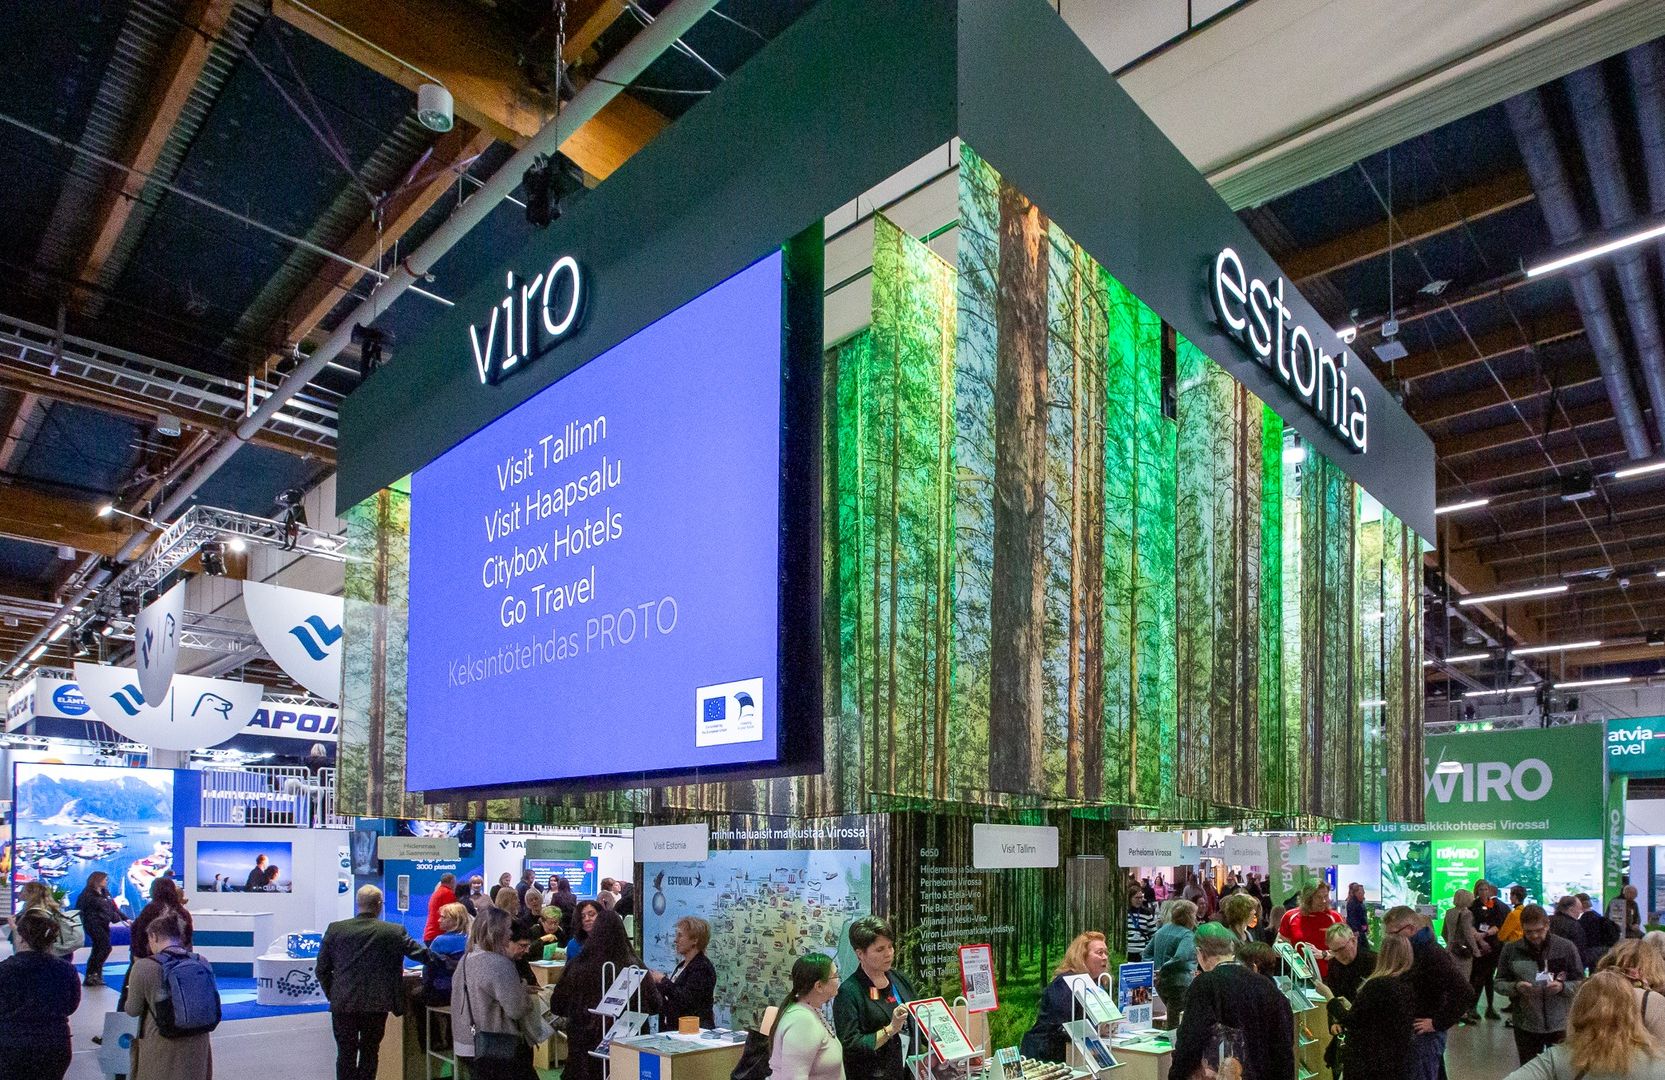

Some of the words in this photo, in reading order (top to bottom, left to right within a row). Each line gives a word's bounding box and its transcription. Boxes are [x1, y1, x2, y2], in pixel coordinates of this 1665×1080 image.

[470, 256, 580, 384] viro
[1216, 247, 1367, 454] estonia
[497, 448, 534, 491] Visit
[539, 415, 607, 470] Tallinn
[485, 501, 521, 543] Visit
[525, 456, 622, 527] Haapsalu
[482, 543, 548, 589] Citybox
[553, 506, 623, 562] Hotels
[500, 596, 526, 628] Go
[532, 566, 595, 617] Travel
[449, 631, 579, 688] Keksintötehdas
[586, 595, 678, 653] PROTO
[246, 708, 338, 735] APOJ
[1608, 726, 1653, 741] atvia
[1373, 823, 1397, 833] Uusi
[1400, 821, 1496, 832] suosikkikohteesi
[1500, 819, 1549, 830] Virossa!
[711, 829, 735, 840] mihin
[736, 827, 772, 840] haluaisit
[774, 826, 824, 839] matkustaa
[826, 825, 869, 838] Virossa!
[653, 841, 665, 850] Visit
[666, 841, 687, 850] Estonia
[1002, 844, 1015, 854] Visit
[1017, 843, 1037, 854] Tallinn
[1128, 848, 1154, 856] Perheloma
[1155, 848, 1172, 857] Virossa
[667, 876, 692, 886] ESTONIA
[920, 878, 957, 887] Perheloma
[958, 878, 982, 886] Virossa
[920, 891, 942, 900] Tartto
[920, 904, 934, 913] The
[935, 903, 953, 912] Baltic
[920, 917, 946, 927] Viljandi
[954, 915, 988, 924] Keski-Viro
[920, 930, 940, 940] Viron
[920, 942, 936, 952] Visit
[920, 955, 936, 965] Visit
[937, 954, 959, 964] Haaps
[920, 968, 936, 978] Visit
